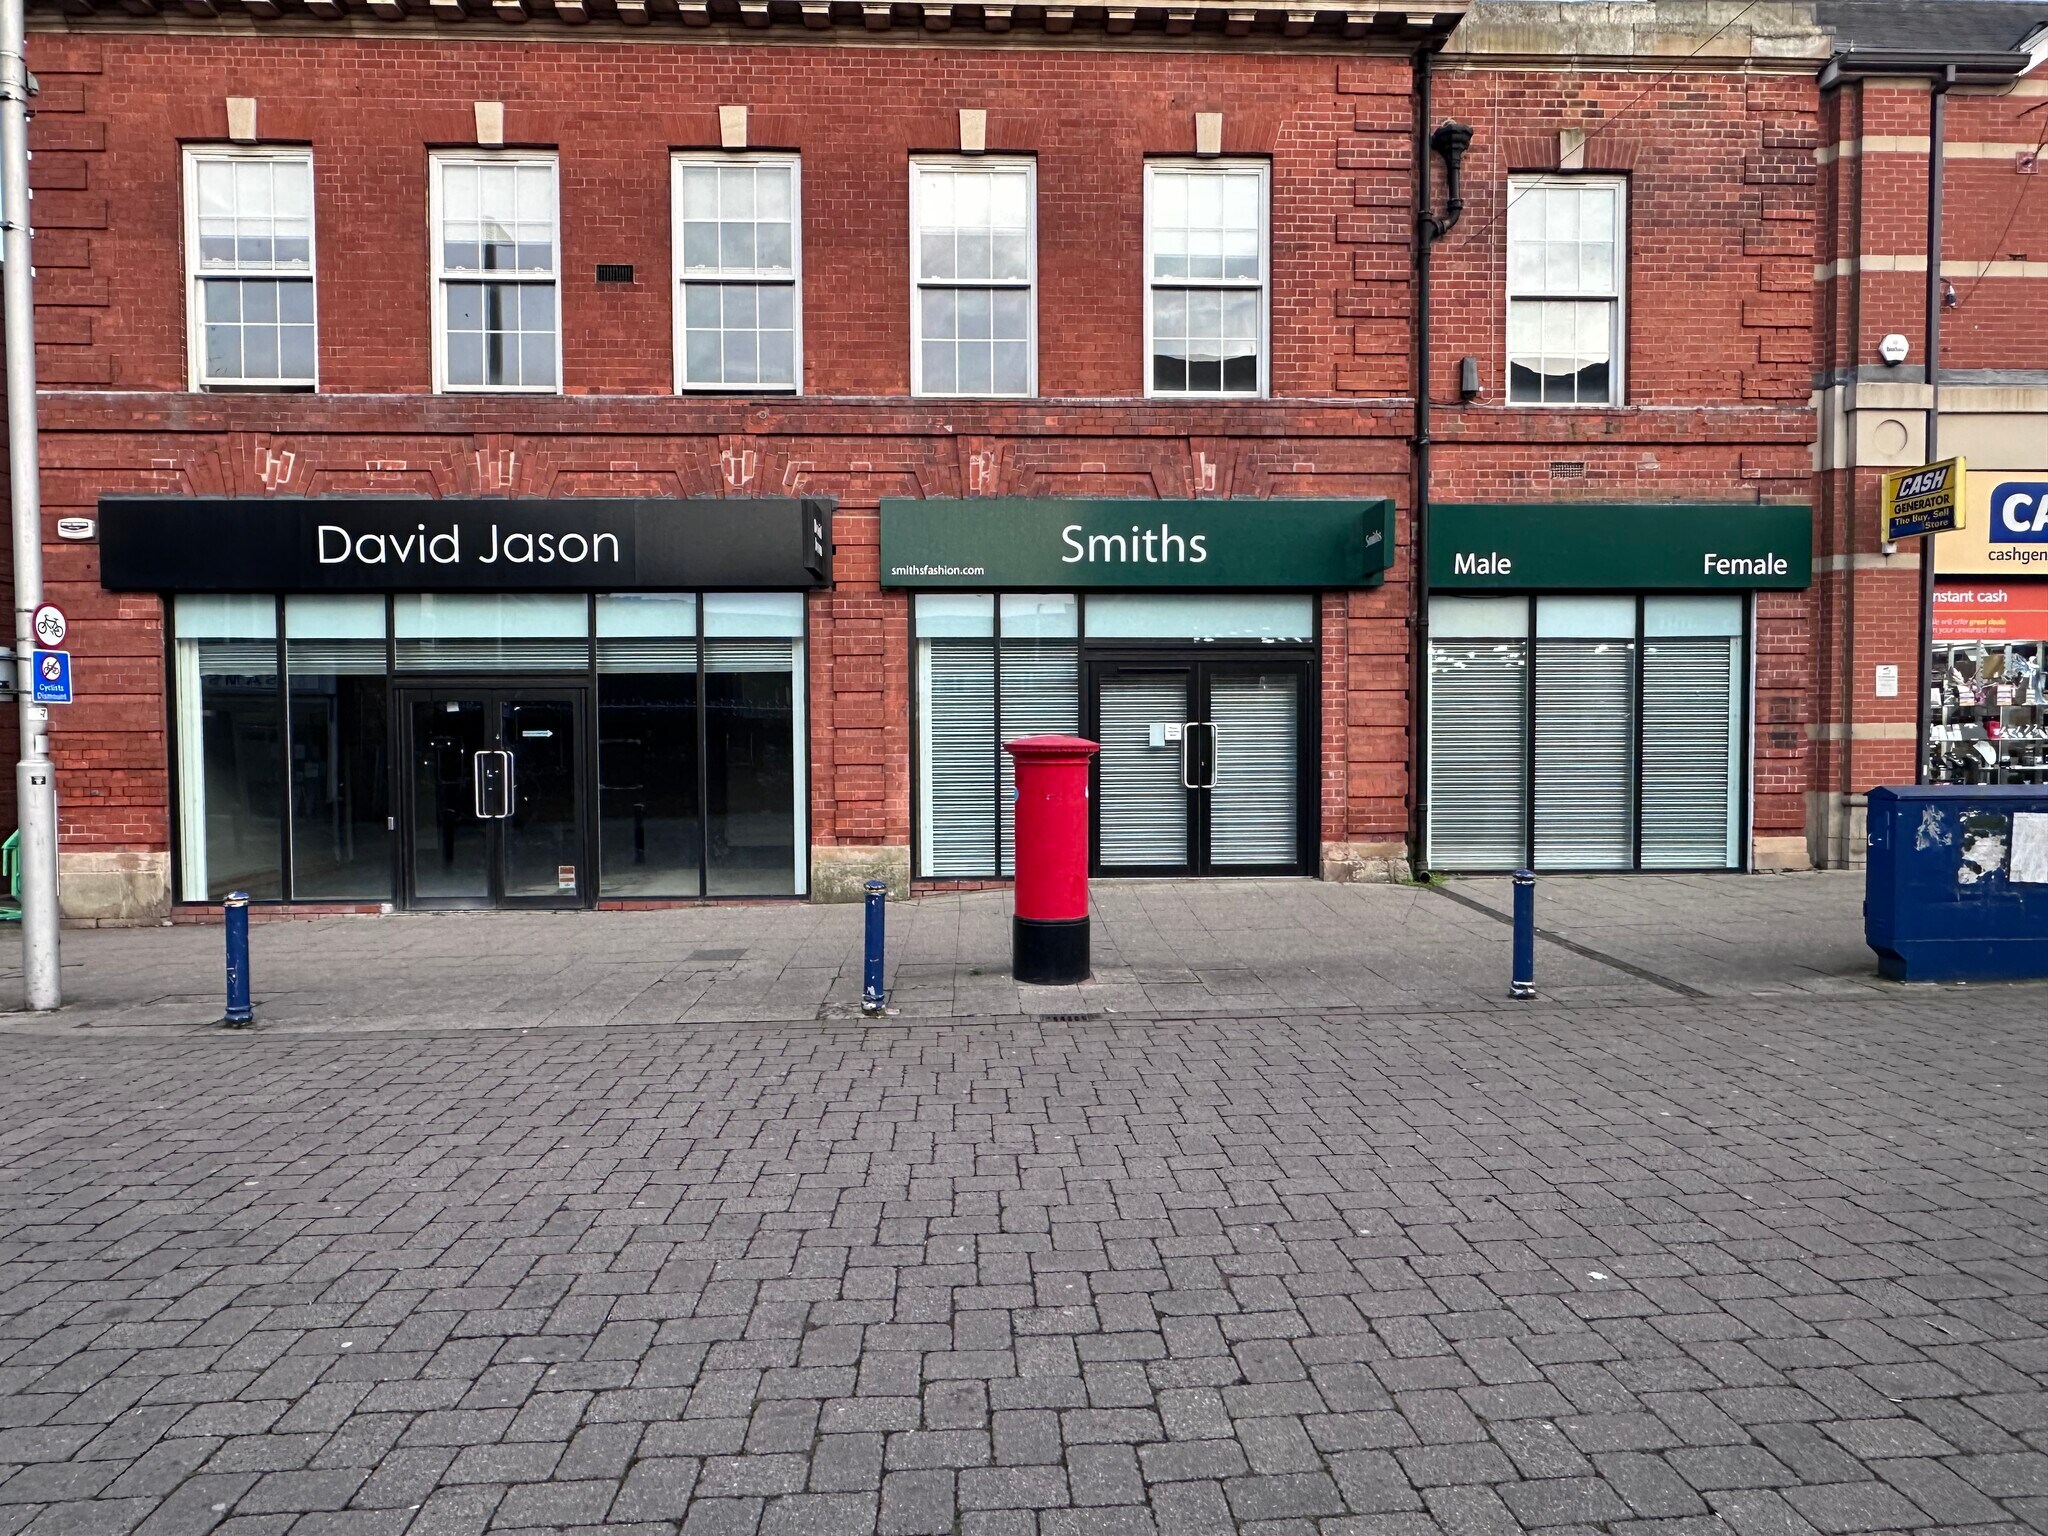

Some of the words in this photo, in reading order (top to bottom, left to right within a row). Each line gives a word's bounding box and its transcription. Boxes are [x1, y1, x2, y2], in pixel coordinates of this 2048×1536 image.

[1899, 468, 1947, 497] CASH
[1894, 494, 1950, 515] GENERATOR
[1895, 517, 1910, 526] The
[1933, 508, 1950, 518] Sell
[1925, 520, 1949, 530] Store
[318, 523, 460, 564] David
[478, 524, 619, 564] Jason
[1061, 523, 1207, 563] Smiths
[1454, 551, 1512, 575] Male
[1704, 552, 1788, 575] Female
[1988, 546, 2048, 565] cashgen
[891, 564, 985, 576] smithsfashion.com
[1932, 590, 1974, 603] nstant
[1977, 589, 2008, 603] cash
[37, 692, 67, 700] Dismount
[39, 683, 65, 692] Cyclists
